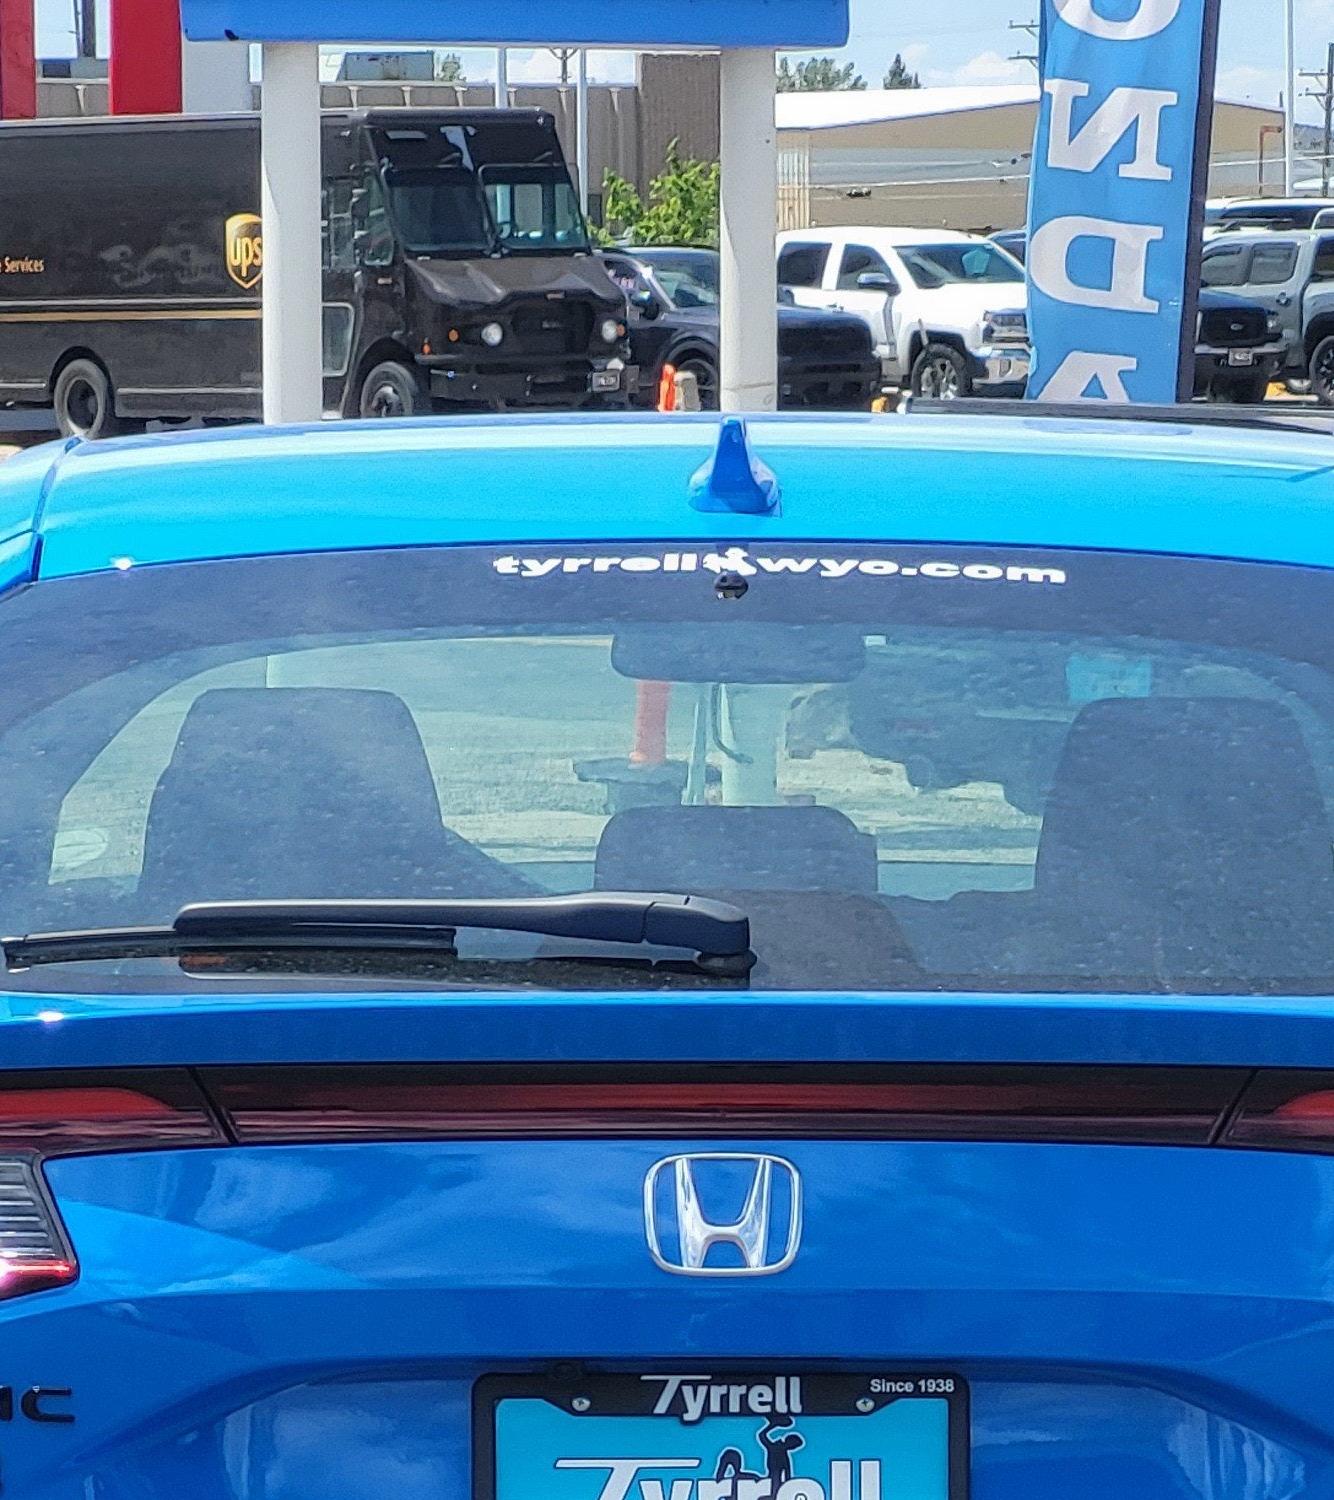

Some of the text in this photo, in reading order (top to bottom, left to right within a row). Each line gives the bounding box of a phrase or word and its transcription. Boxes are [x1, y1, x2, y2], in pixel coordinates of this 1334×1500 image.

[4, 256, 45, 273] Services
[870, 1378, 955, 1393] Since 1938
[640, 1375, 803, 1422] Tyrrell
